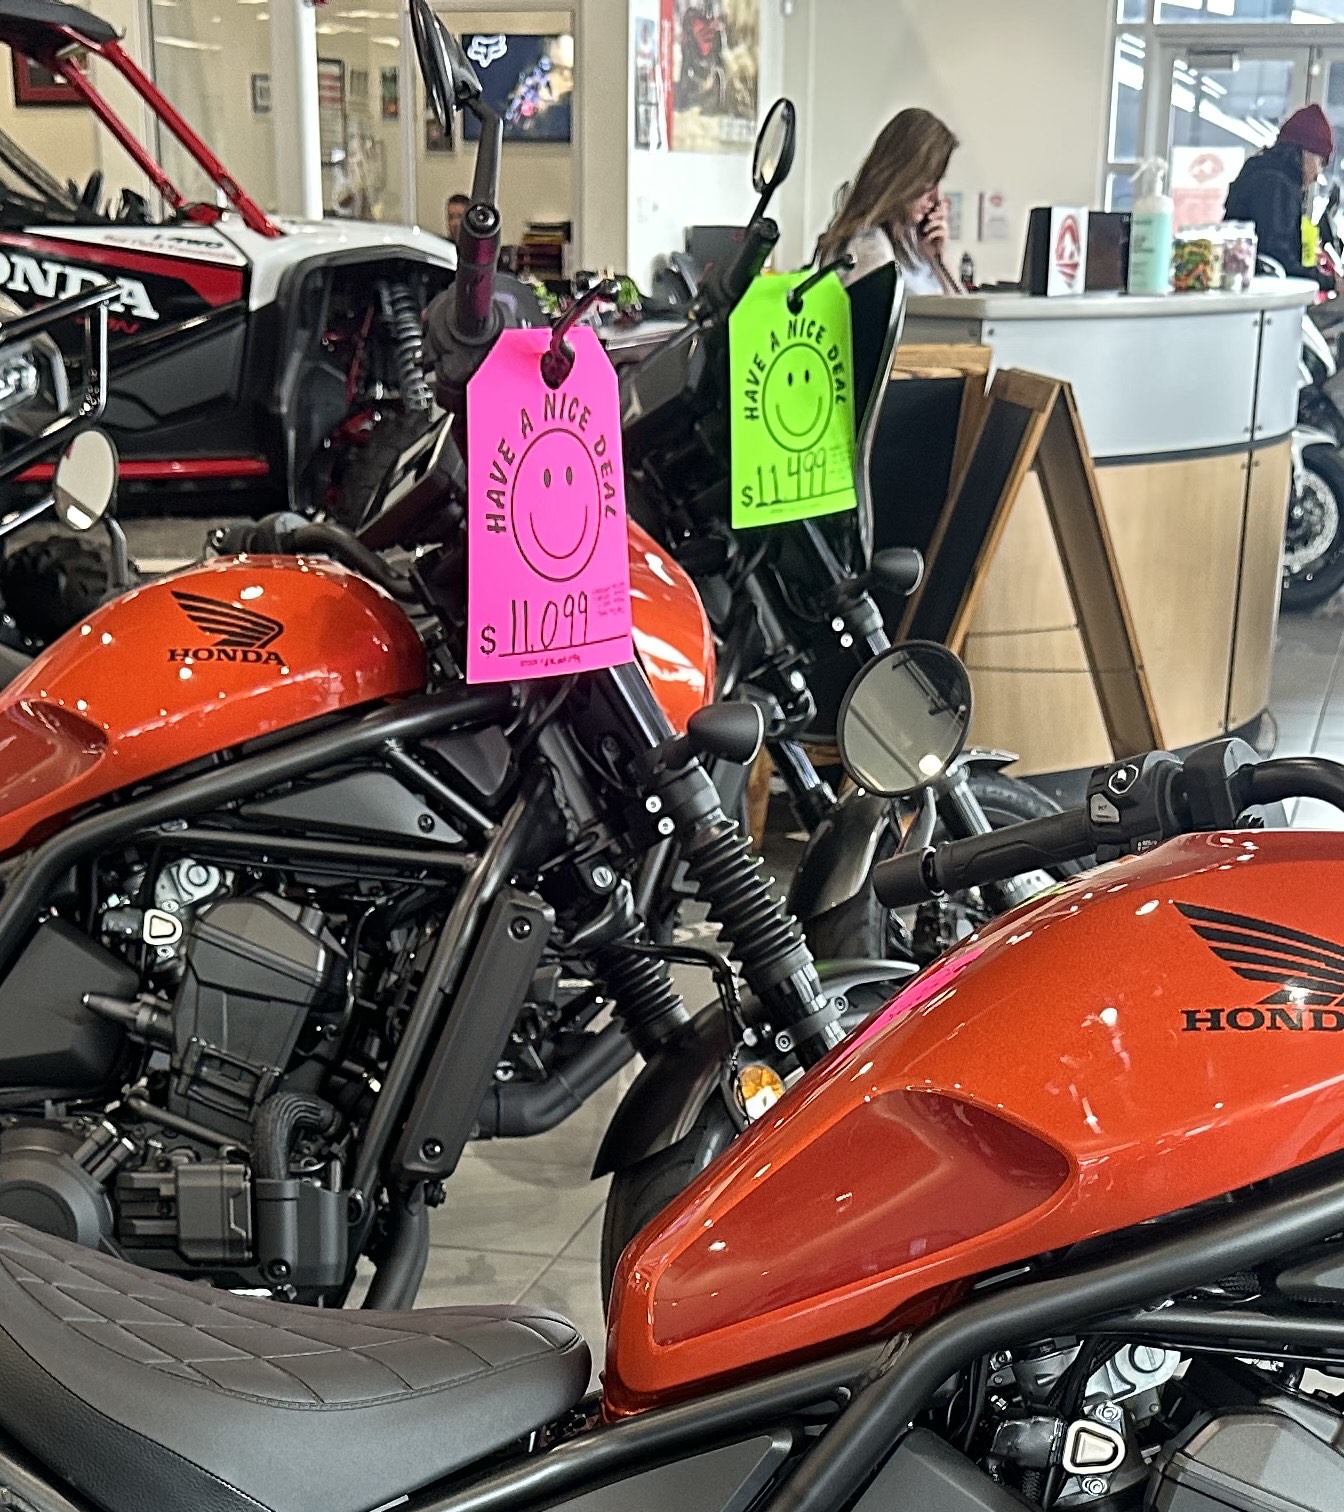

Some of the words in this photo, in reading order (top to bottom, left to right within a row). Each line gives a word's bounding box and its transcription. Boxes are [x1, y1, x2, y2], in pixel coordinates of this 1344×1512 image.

[743, 352, 767, 421] HAVE
[769, 330, 781, 353] A
[787, 317, 827, 345] NICE
[826, 344, 847, 404] DEAL
[485, 438, 516, 534] HAVE
[520, 408, 534, 440] A
[543, 392, 592, 432] NICE
[593, 434, 617, 519] DEAL
[167, 648, 286, 667] HONDA
